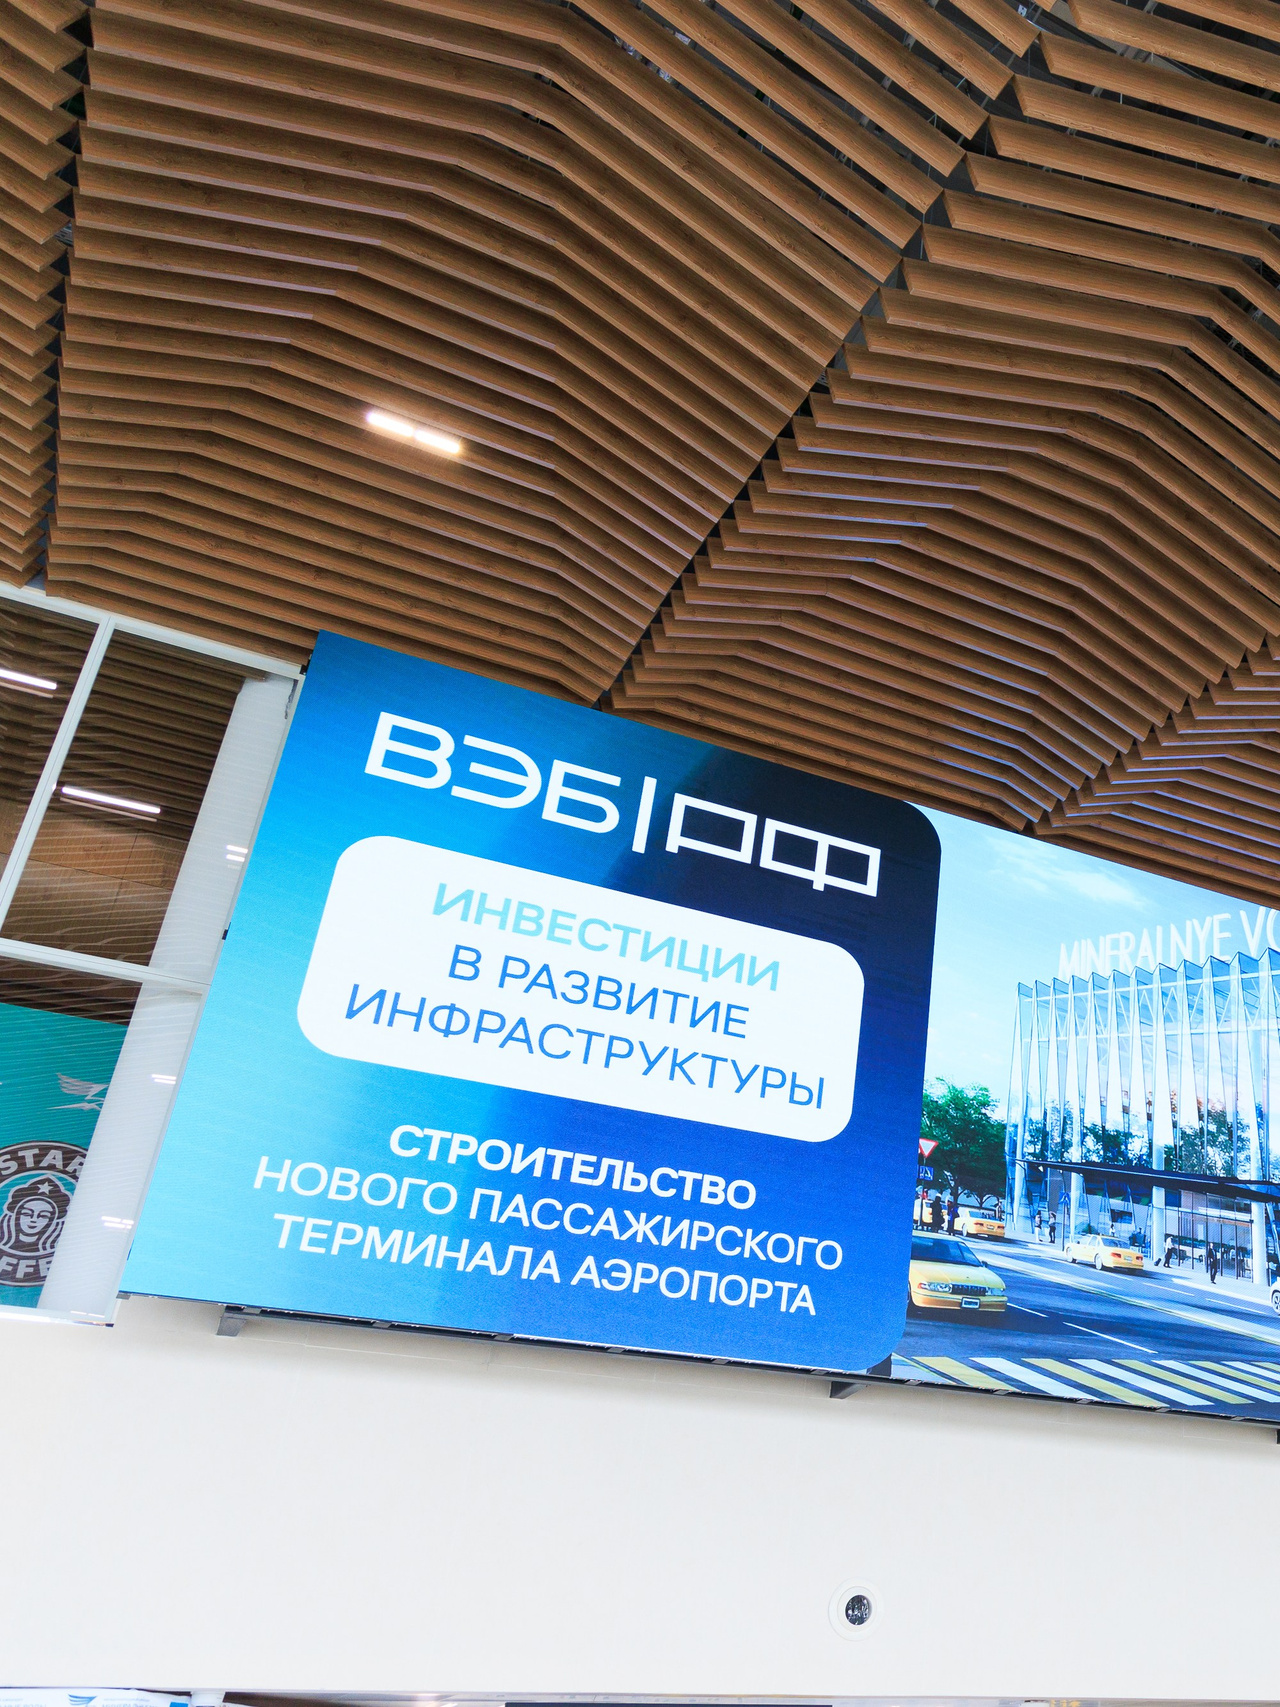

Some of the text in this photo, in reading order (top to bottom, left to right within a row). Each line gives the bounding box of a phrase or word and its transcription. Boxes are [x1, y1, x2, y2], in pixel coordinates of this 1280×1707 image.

[431, 882, 781, 992] ИНВЕСТИЦИИ
[448, 944, 751, 1040] В РАЗВИТИЕ
[344, 983, 826, 1110] ИНФРАСТРУКТУРЫ
[253, 1155, 844, 1271] НОВОГО ПАССАЖИРСКОГО
[389, 1124, 757, 1210] СТРОИТЕЛЬСТВО
[272, 1212, 817, 1317] ТЕРМИНАЛА АЭРОПОРТА
